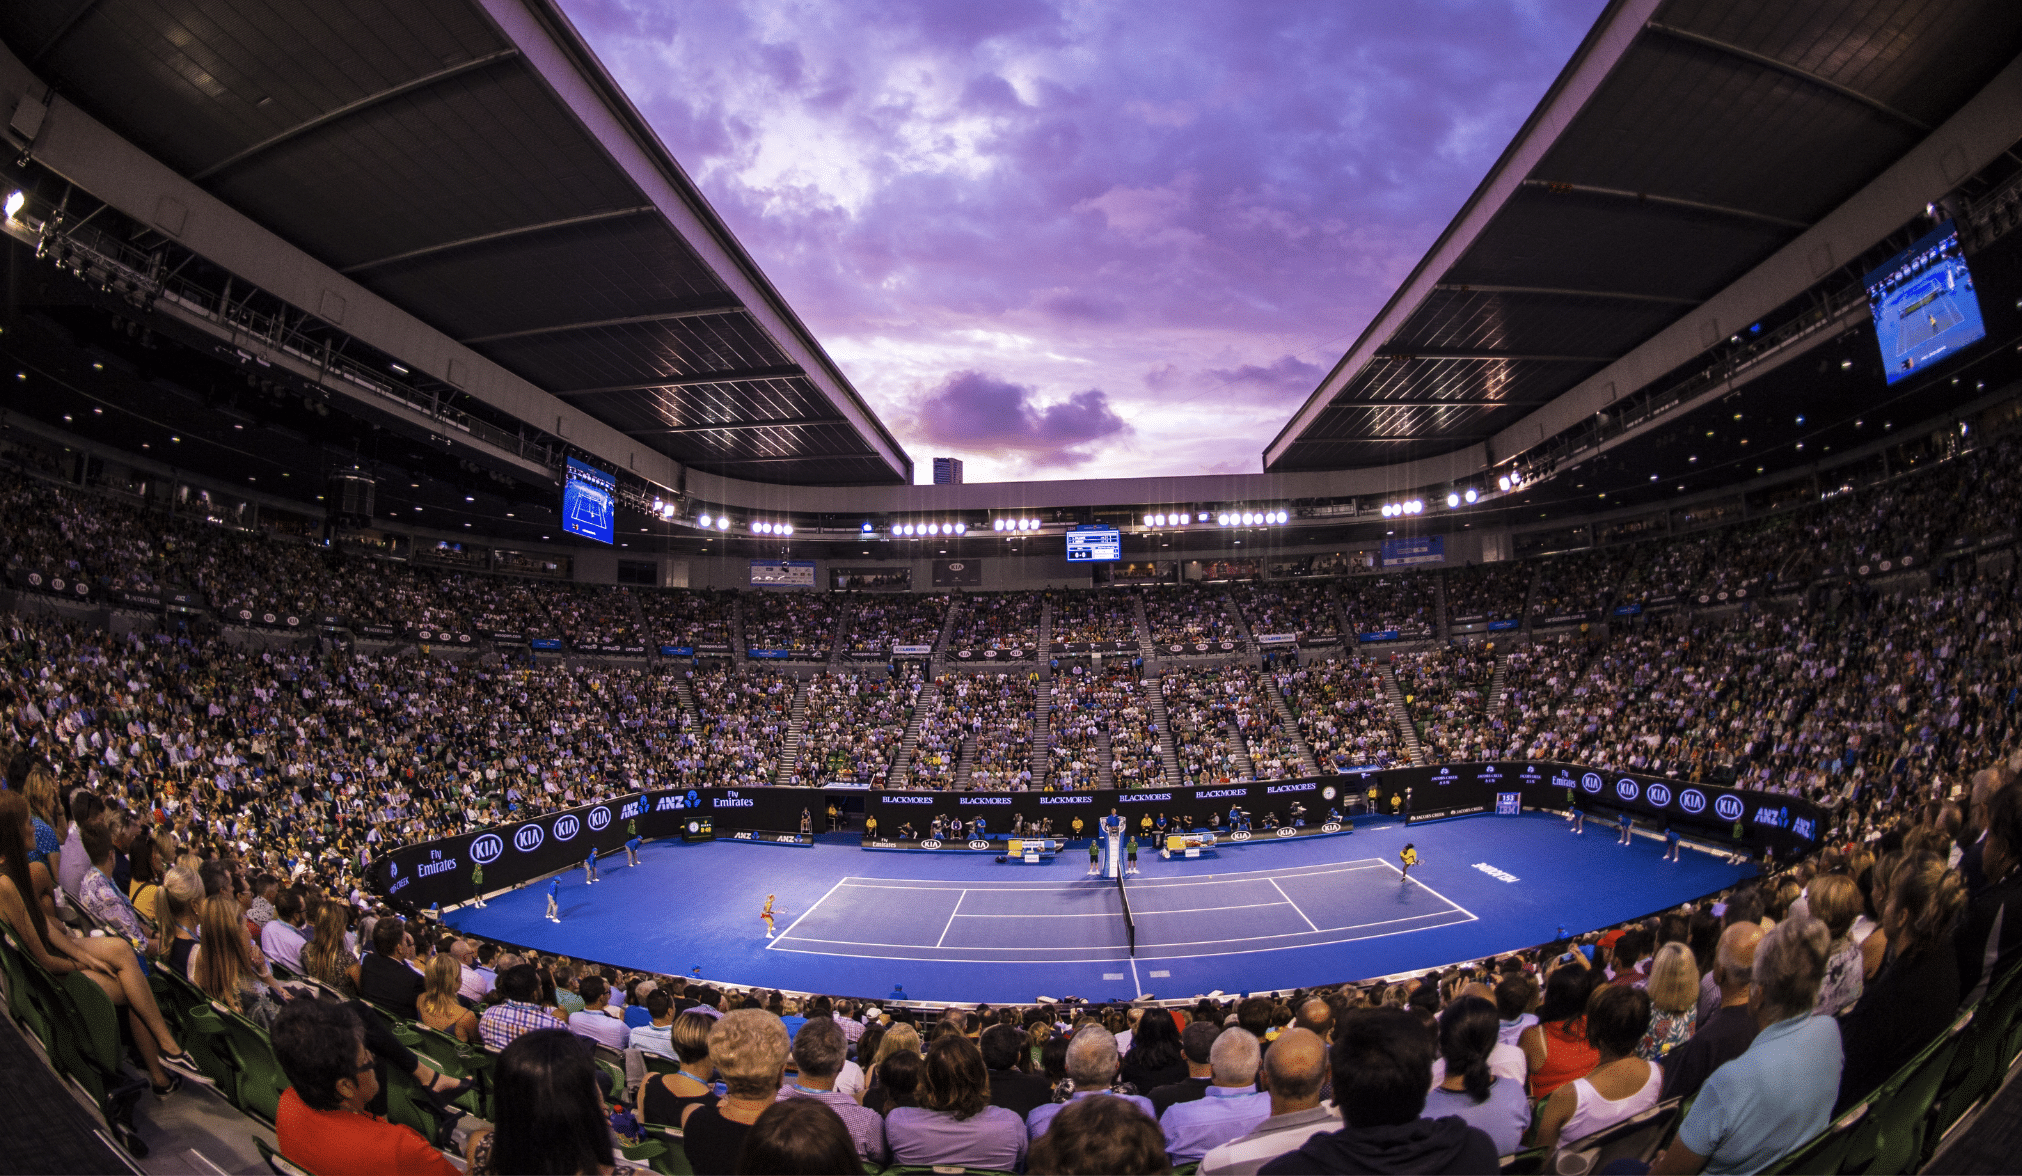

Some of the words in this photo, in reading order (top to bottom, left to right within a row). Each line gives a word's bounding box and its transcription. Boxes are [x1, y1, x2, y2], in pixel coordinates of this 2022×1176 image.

[1552, 776, 1577, 789] Emirates
[1196, 788, 1248, 799] BLACKMORES
[1267, 783, 1317, 794] BLACKMORES
[728, 790, 739, 799] Fly
[1119, 793, 1172, 803] BLACKMORES
[656, 795, 685, 811] ANZ
[713, 797, 755, 808] Emirates
[882, 796, 934, 805] BLACKMORES
[960, 797, 1012, 805] BLACKMORES
[1040, 796, 1093, 805] BLACKMORES
[621, 801, 639, 820] ANZ
[1753, 807, 1779, 826] ANZ
[1792, 817, 1810, 839] ANZ
[734, 832, 752, 840] ANZ
[430, 850, 442, 860] Fly
[417, 859, 457, 878] Emirates
